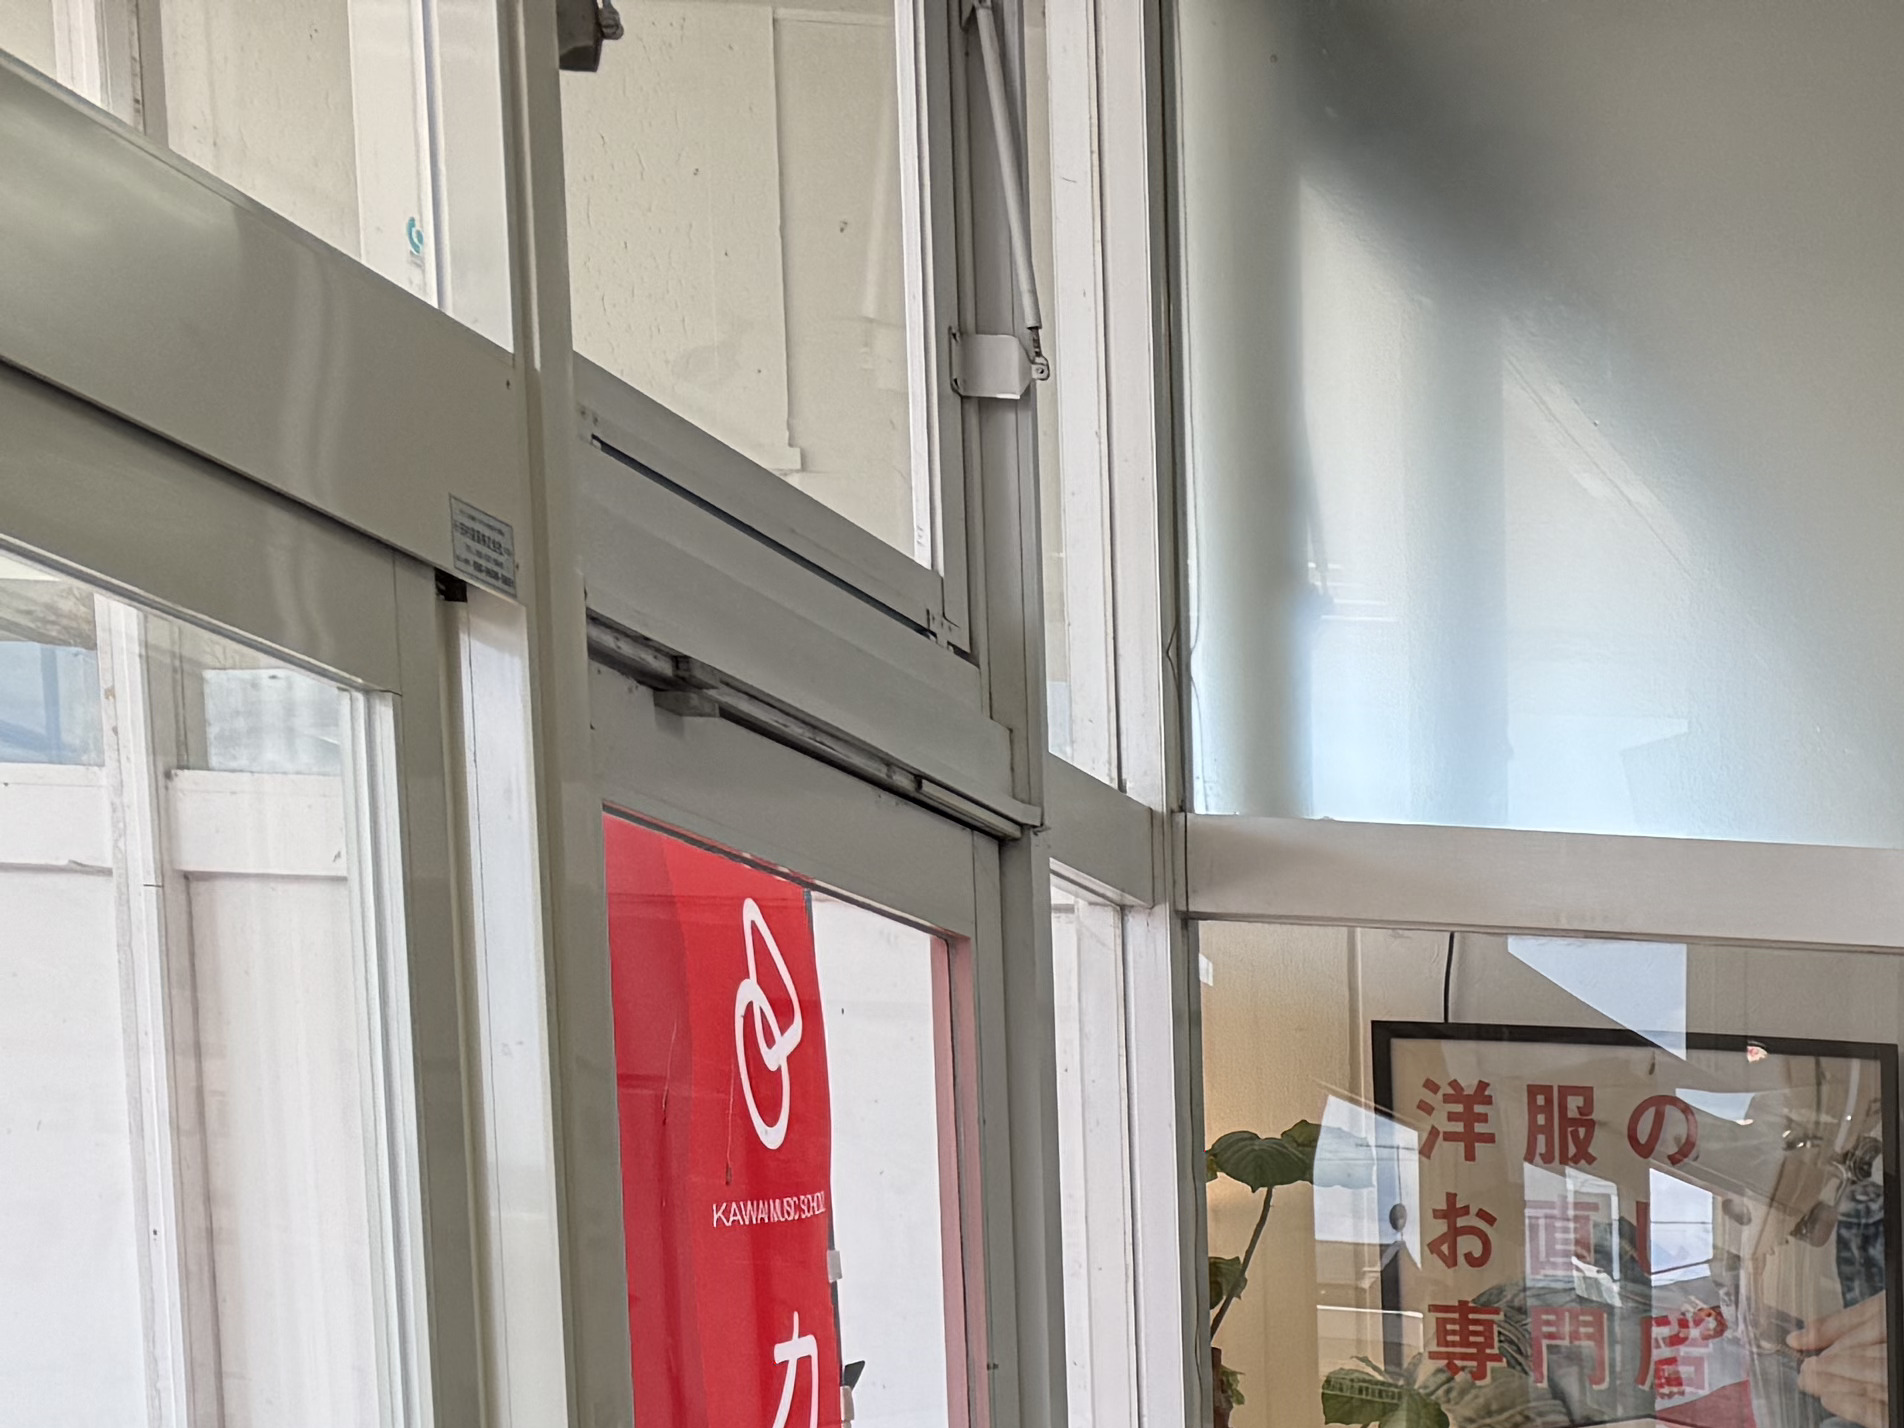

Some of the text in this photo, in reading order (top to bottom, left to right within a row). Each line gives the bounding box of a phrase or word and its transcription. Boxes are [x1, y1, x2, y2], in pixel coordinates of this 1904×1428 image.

[1418, 1077, 1699, 1166] 洋服の
[1426, 1301, 1722, 1400] 専門店
